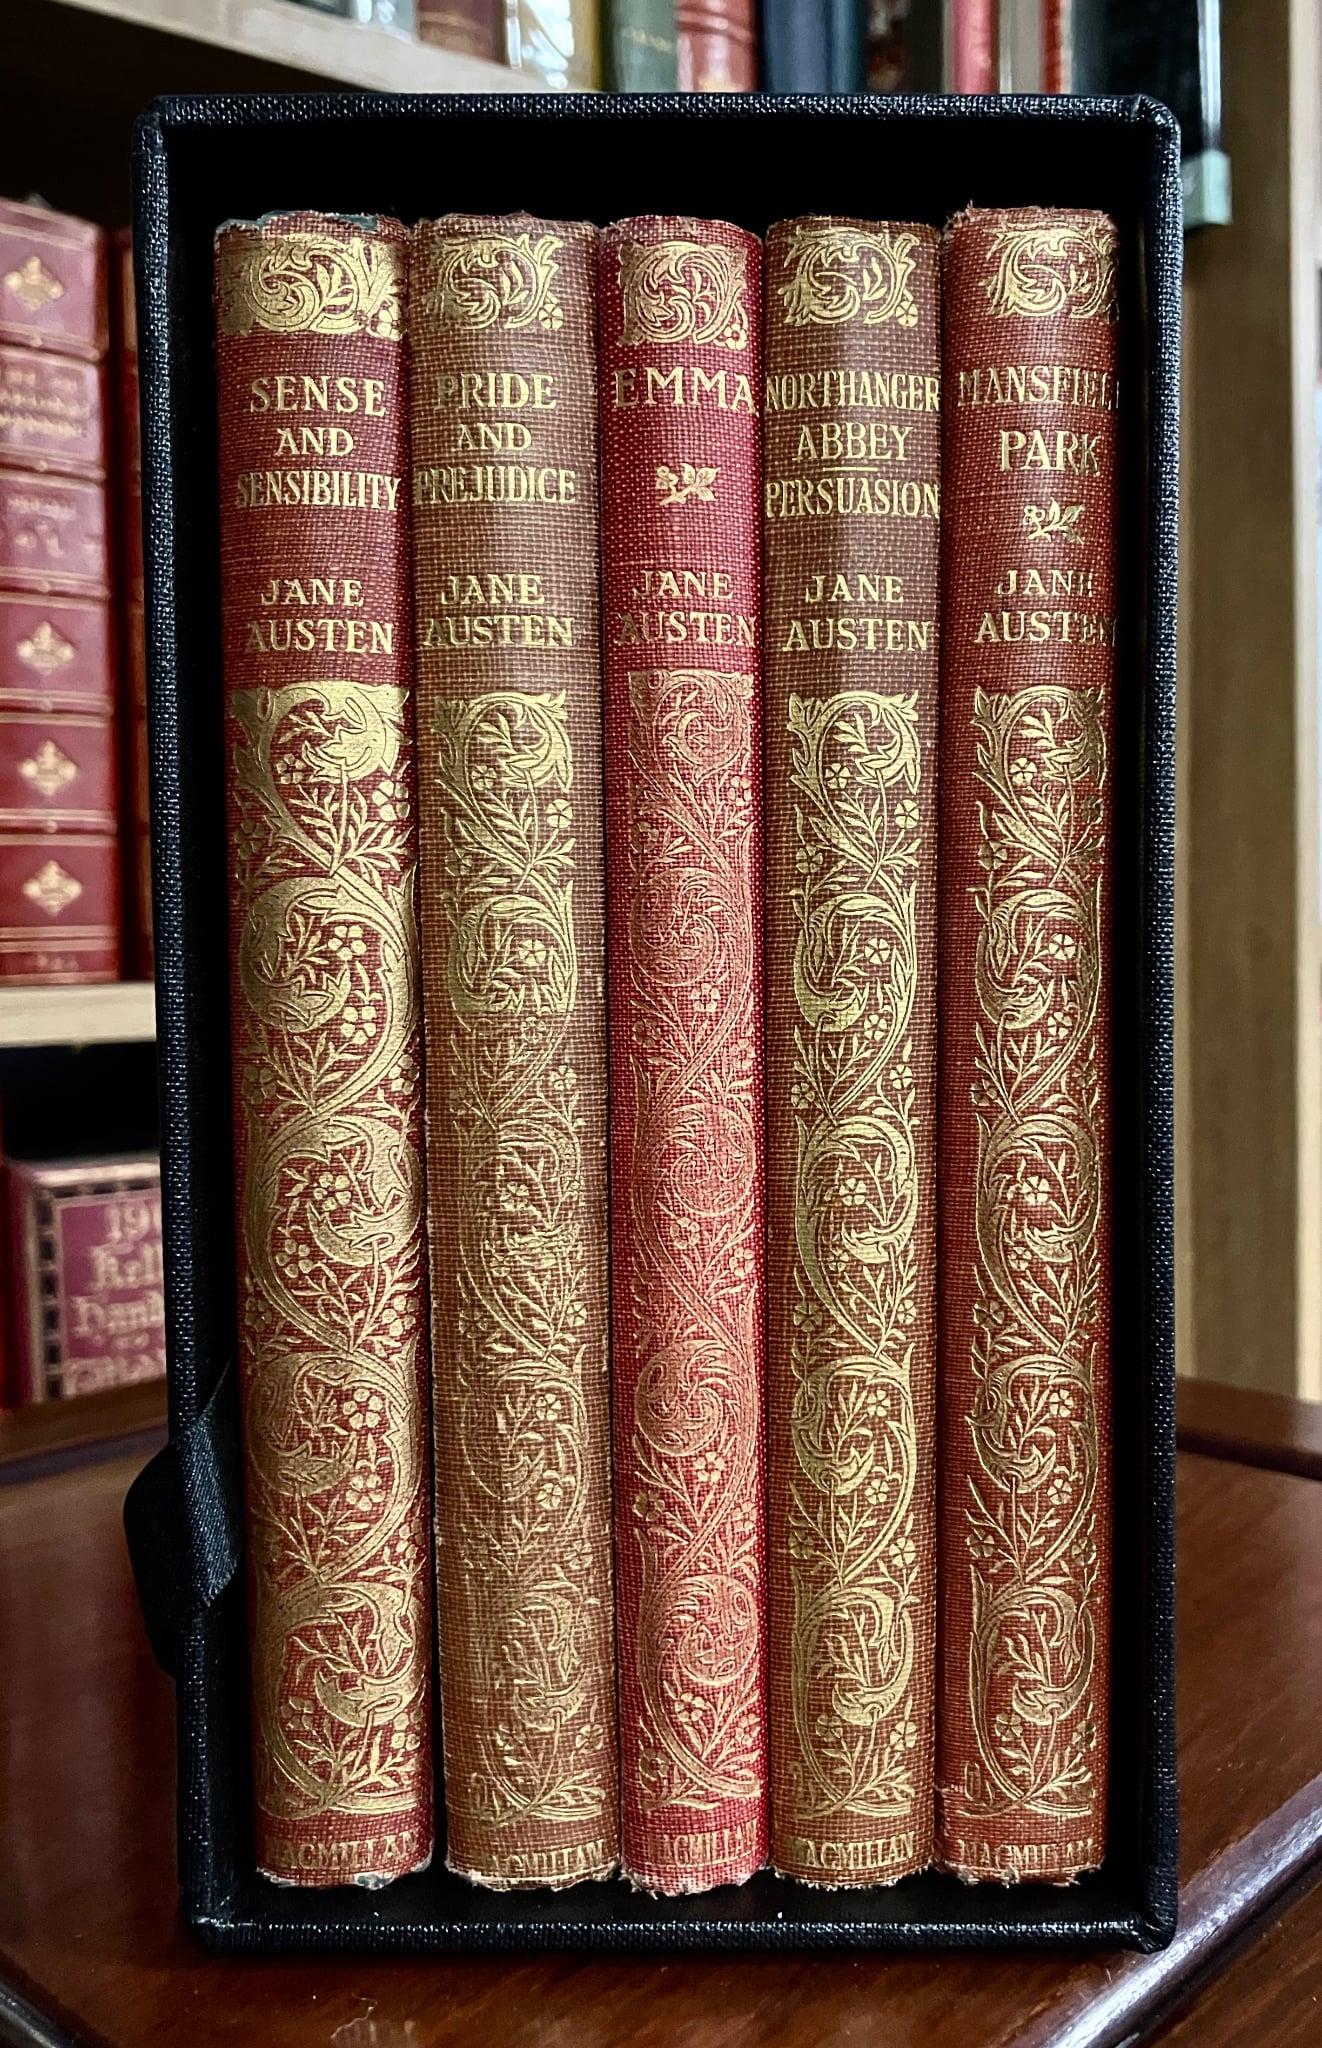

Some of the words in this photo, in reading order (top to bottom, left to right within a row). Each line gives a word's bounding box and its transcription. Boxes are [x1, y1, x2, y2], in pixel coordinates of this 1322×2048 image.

[250, 375, 387, 417] SENSE
[435, 372, 557, 410] PRIDE
[614, 366, 759, 416] EMMA
[766, 370, 940, 412] NORTHANGER
[274, 426, 355, 457] AND
[453, 421, 532, 452] AND
[792, 422, 913, 461] ABBEY
[1000, 429, 1101, 476] PARK
[237, 470, 401, 511] SENSIBILITY
[415, 465, 576, 504] PREJUDICE
[766, 478, 940, 519] PERSUASION
[261, 578, 364, 607] JANE
[441, 573, 545, 605] JANE
[633, 570, 734, 600] JANE
[805, 574, 904, 604] JANE
[245, 618, 394, 655] AUSTEN
[424, 615, 574, 648] AUSTEN
[615, 610, 757, 648] AUSTEN
[782, 618, 931, 652] AUSTEN
